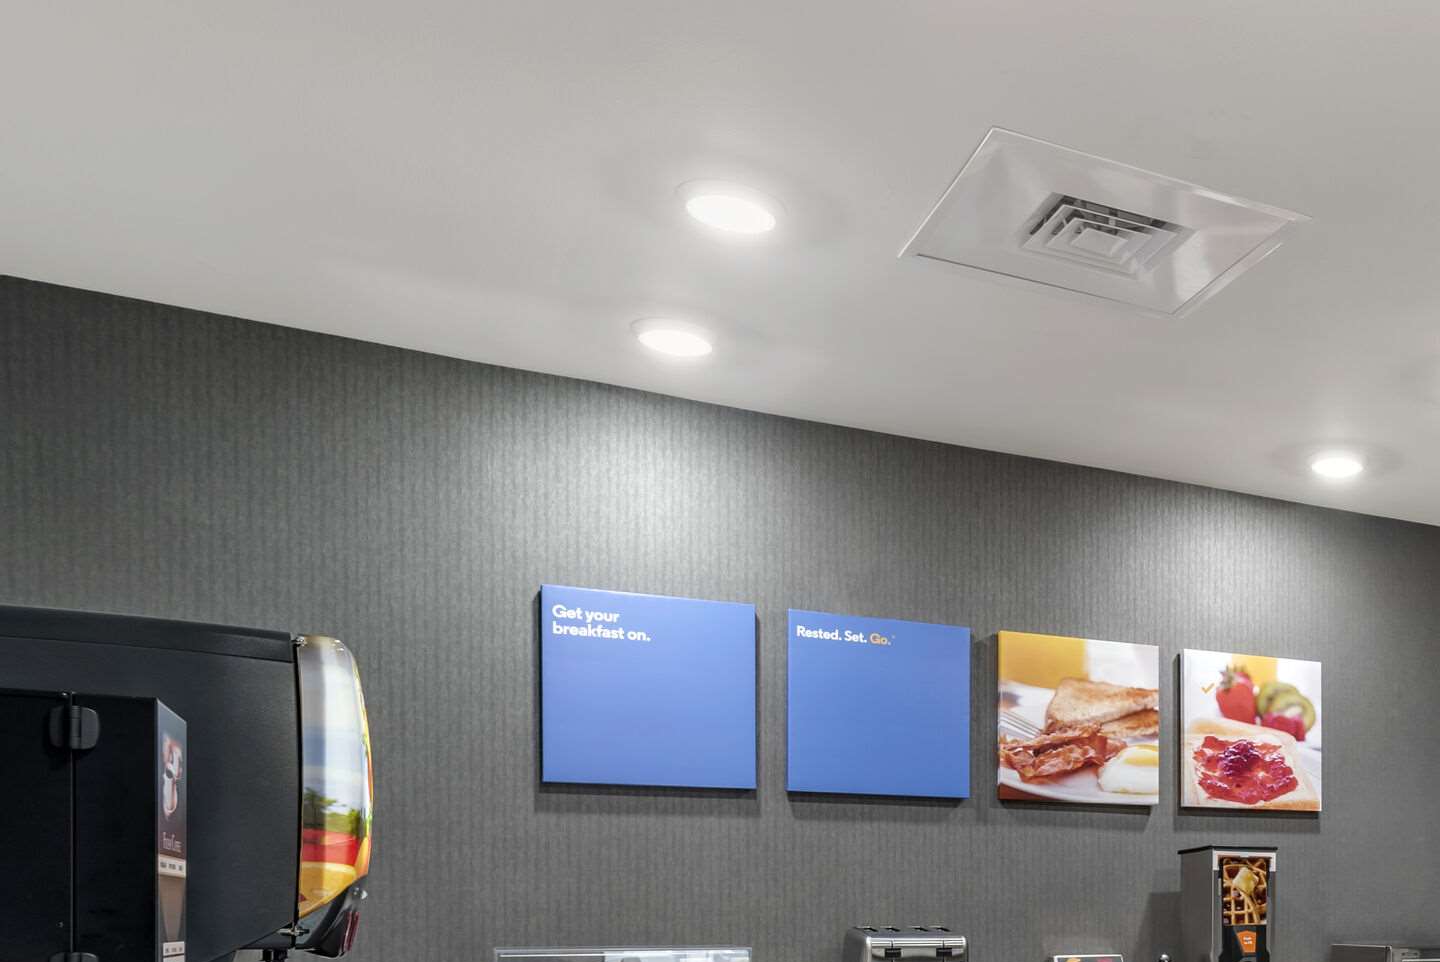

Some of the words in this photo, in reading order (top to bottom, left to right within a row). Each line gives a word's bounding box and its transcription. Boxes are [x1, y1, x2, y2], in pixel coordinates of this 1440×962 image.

[552, 604, 583, 619] Get
[584, 610, 620, 623] your
[552, 620, 625, 640] breakfast
[626, 630, 651, 642] on.
[796, 624, 842, 641] Rested.
[844, 630, 868, 644] Set.
